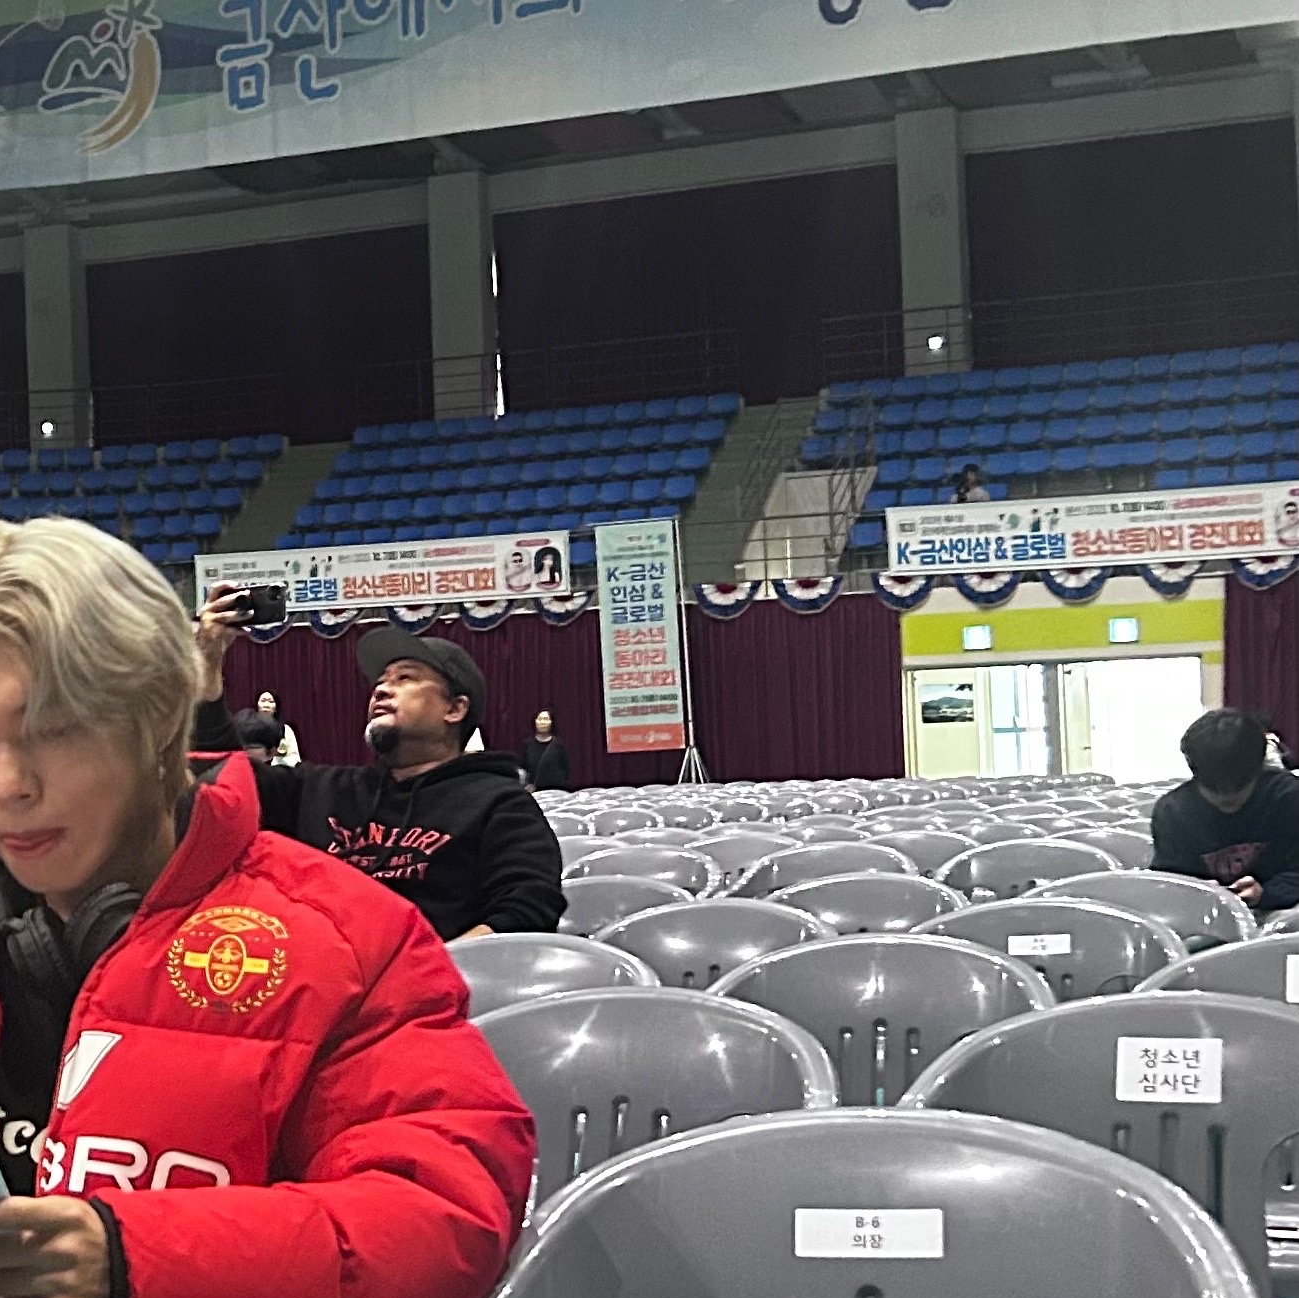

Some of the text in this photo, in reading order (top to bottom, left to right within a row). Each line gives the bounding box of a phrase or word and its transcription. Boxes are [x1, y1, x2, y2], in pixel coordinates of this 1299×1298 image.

[897, 519, 1264, 565] K-금산인삼 & 글로벌 청소년동아리 경진대회
[606, 561, 667, 582] K-금산
[294, 568, 496, 603] 글로벌 청소년동아리 경진대회
[611, 582, 663, 603] 인삼 &
[611, 604, 665, 624] 글로벌
[1139, 1048, 1201, 1069] 청소년
[1138, 1073, 1202, 1094] 심사단
[852, 1234, 883, 1248] 의장
